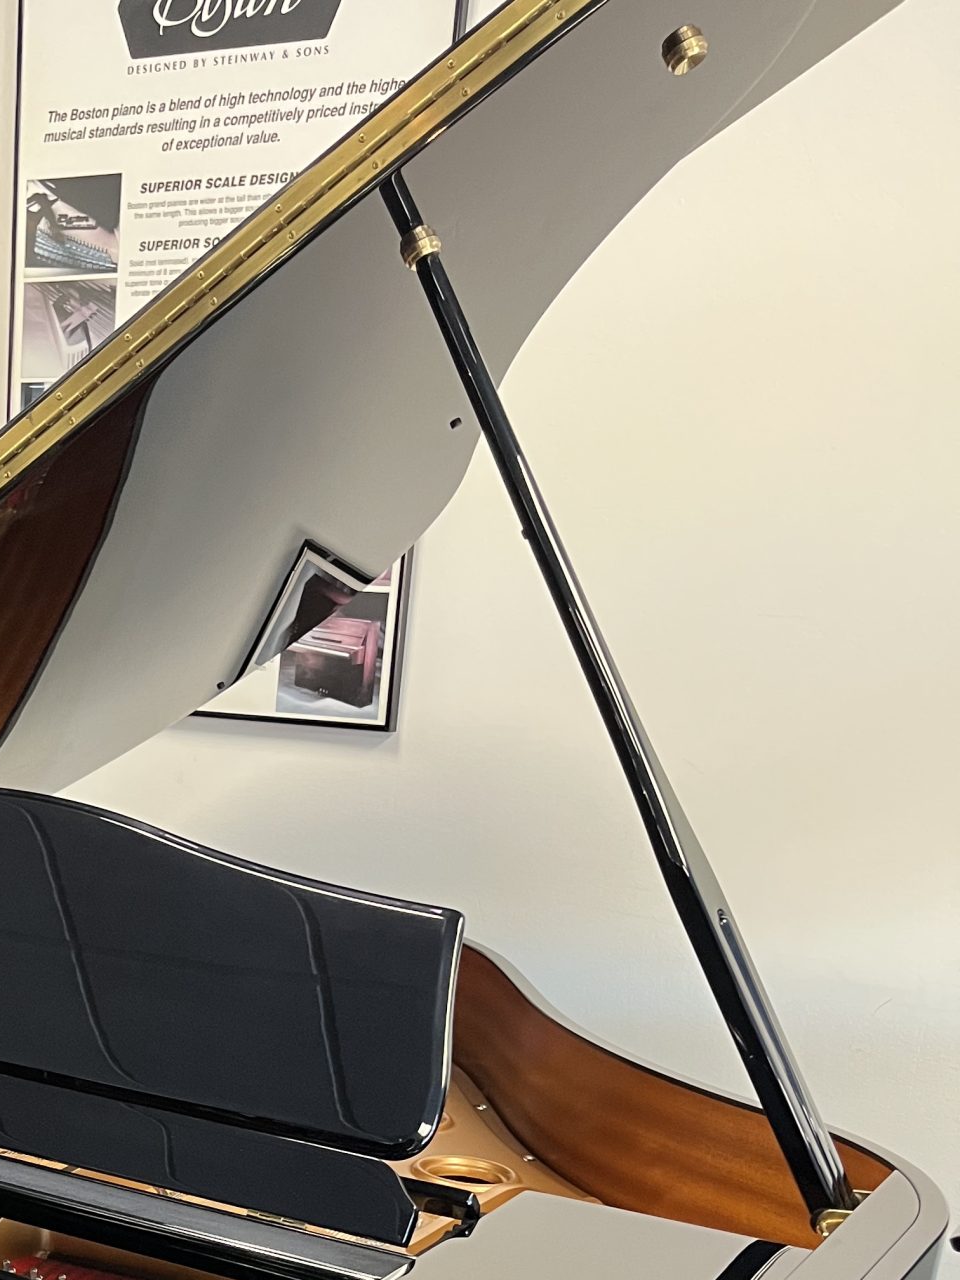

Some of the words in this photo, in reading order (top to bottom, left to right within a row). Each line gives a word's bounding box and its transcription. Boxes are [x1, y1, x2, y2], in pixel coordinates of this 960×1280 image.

[127, 60, 187, 75] DESIGNED
[193, 58, 207, 68] BY
[213, 51, 276, 66] STEINWAY
[281, 50, 289, 58] &
[296, 45, 330, 57] SONS
[48, 110, 68, 123] The
[70, 108, 109, 121] Boston
[111, 104, 143, 120] piano
[146, 100, 156, 114] is
[158, 102, 166, 113] a
[168, 96, 202, 111] blend
[204, 94, 218, 108] of
[218, 92, 245, 109] high
[248, 86, 316, 105] technology
[319, 82, 344, 97] and
[346, 80, 366, 95] the
[369, 78, 406, 95] highe
[44, 127, 87, 143] musical
[88, 122, 144, 139] standards
[146, 117, 196, 133] resulting
[199, 115, 211, 129] in
[213, 117, 221, 128] a
[223, 107, 305, 127] competitively
[306, 102, 348, 122] priced
[161, 138, 175, 152] of
[175, 132, 244, 152] exceptional
[246, 130, 281, 145] value.
[140, 178, 203, 194] SUPERIOR
[205, 175, 247, 188] SCALE
[138, 238, 200, 252] SUPERIOR
[203, 237, 220, 248] SO
